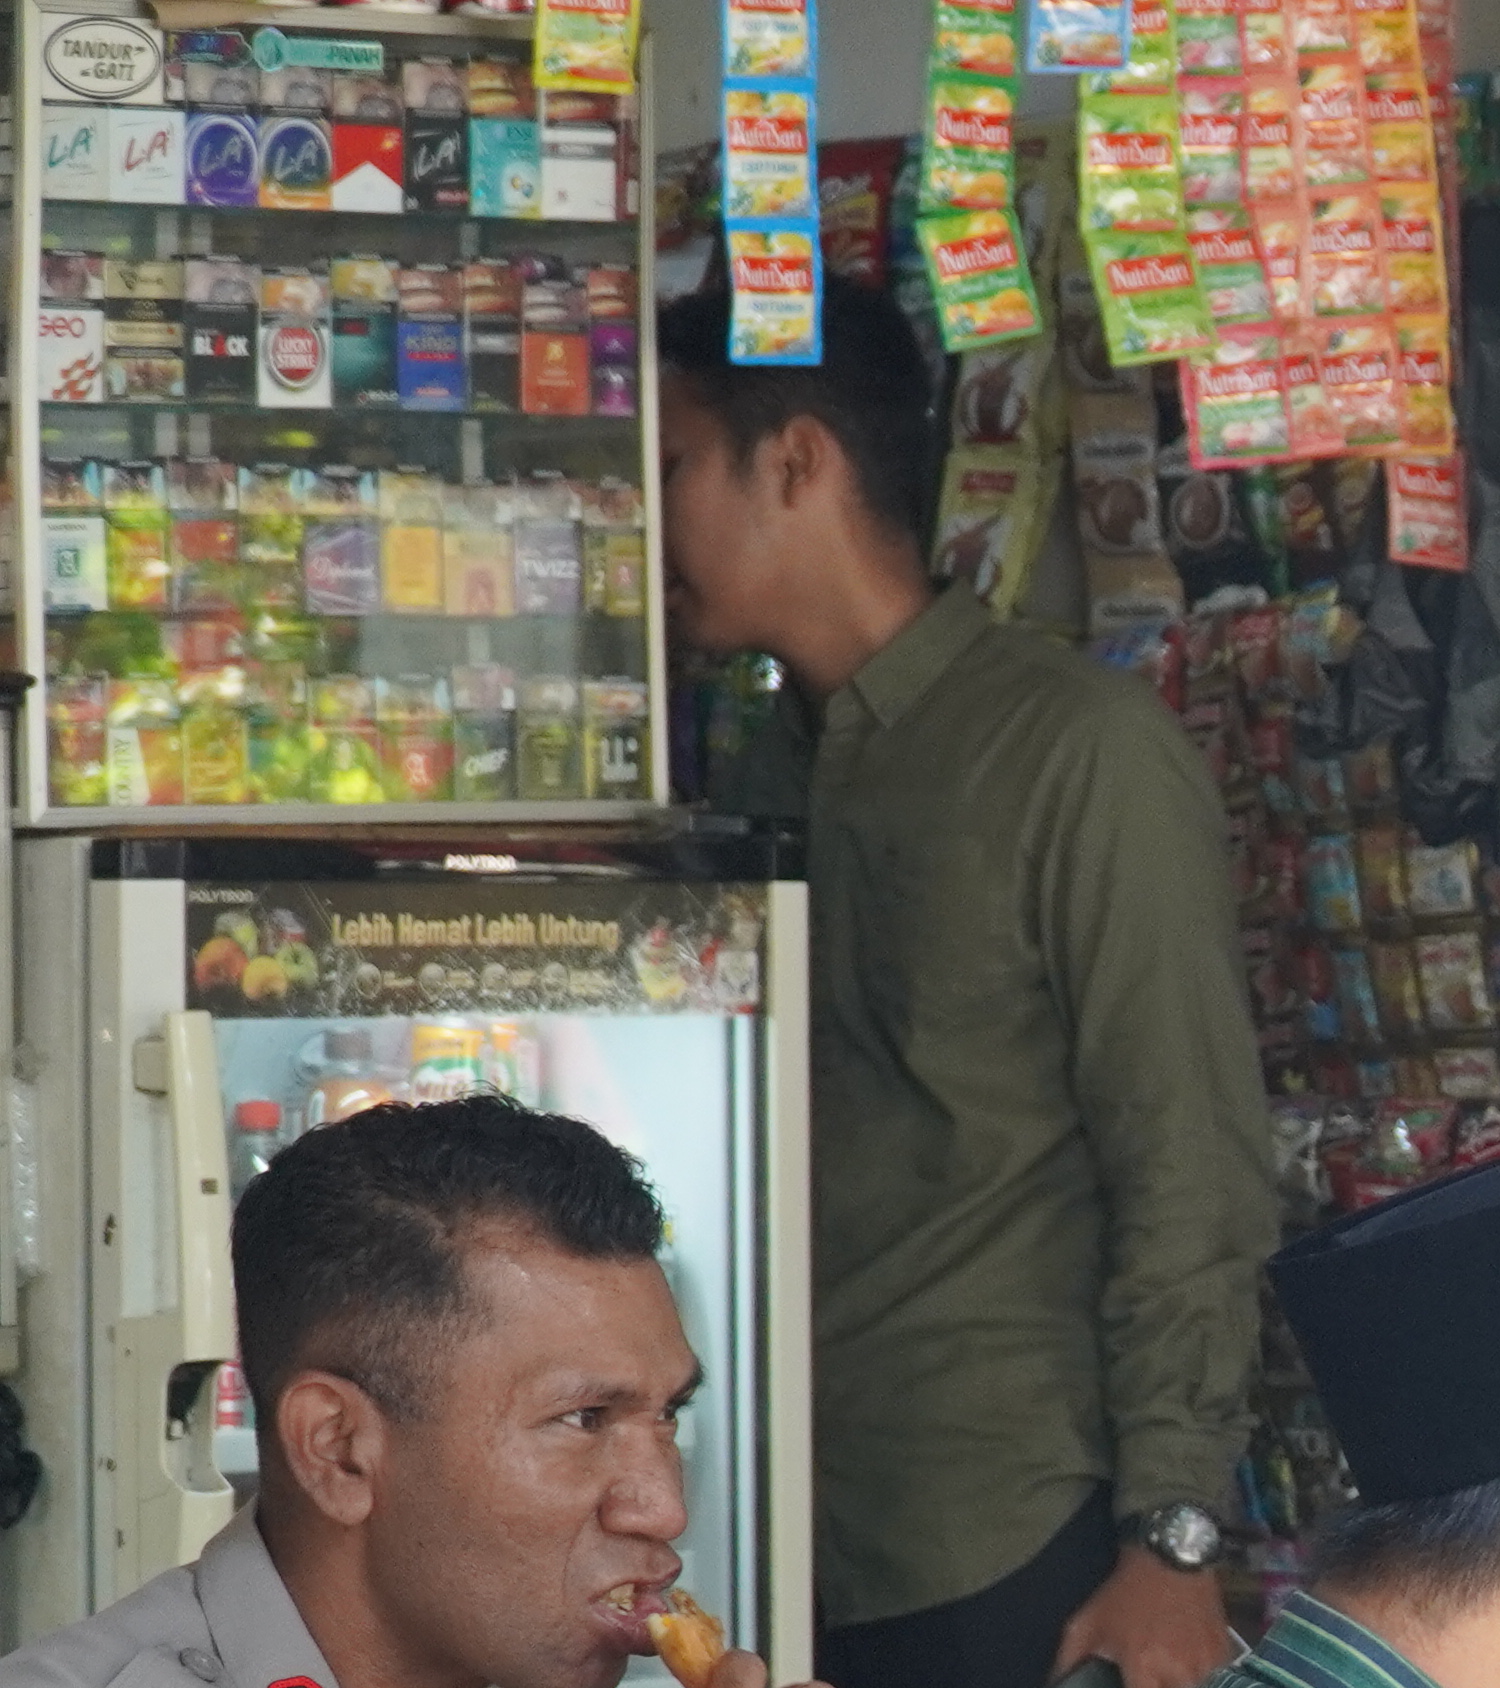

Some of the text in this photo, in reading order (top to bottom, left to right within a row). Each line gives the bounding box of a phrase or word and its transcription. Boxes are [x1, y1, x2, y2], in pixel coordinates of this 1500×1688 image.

[331, 913, 620, 952] Lebih Hemat Lebih Untung
